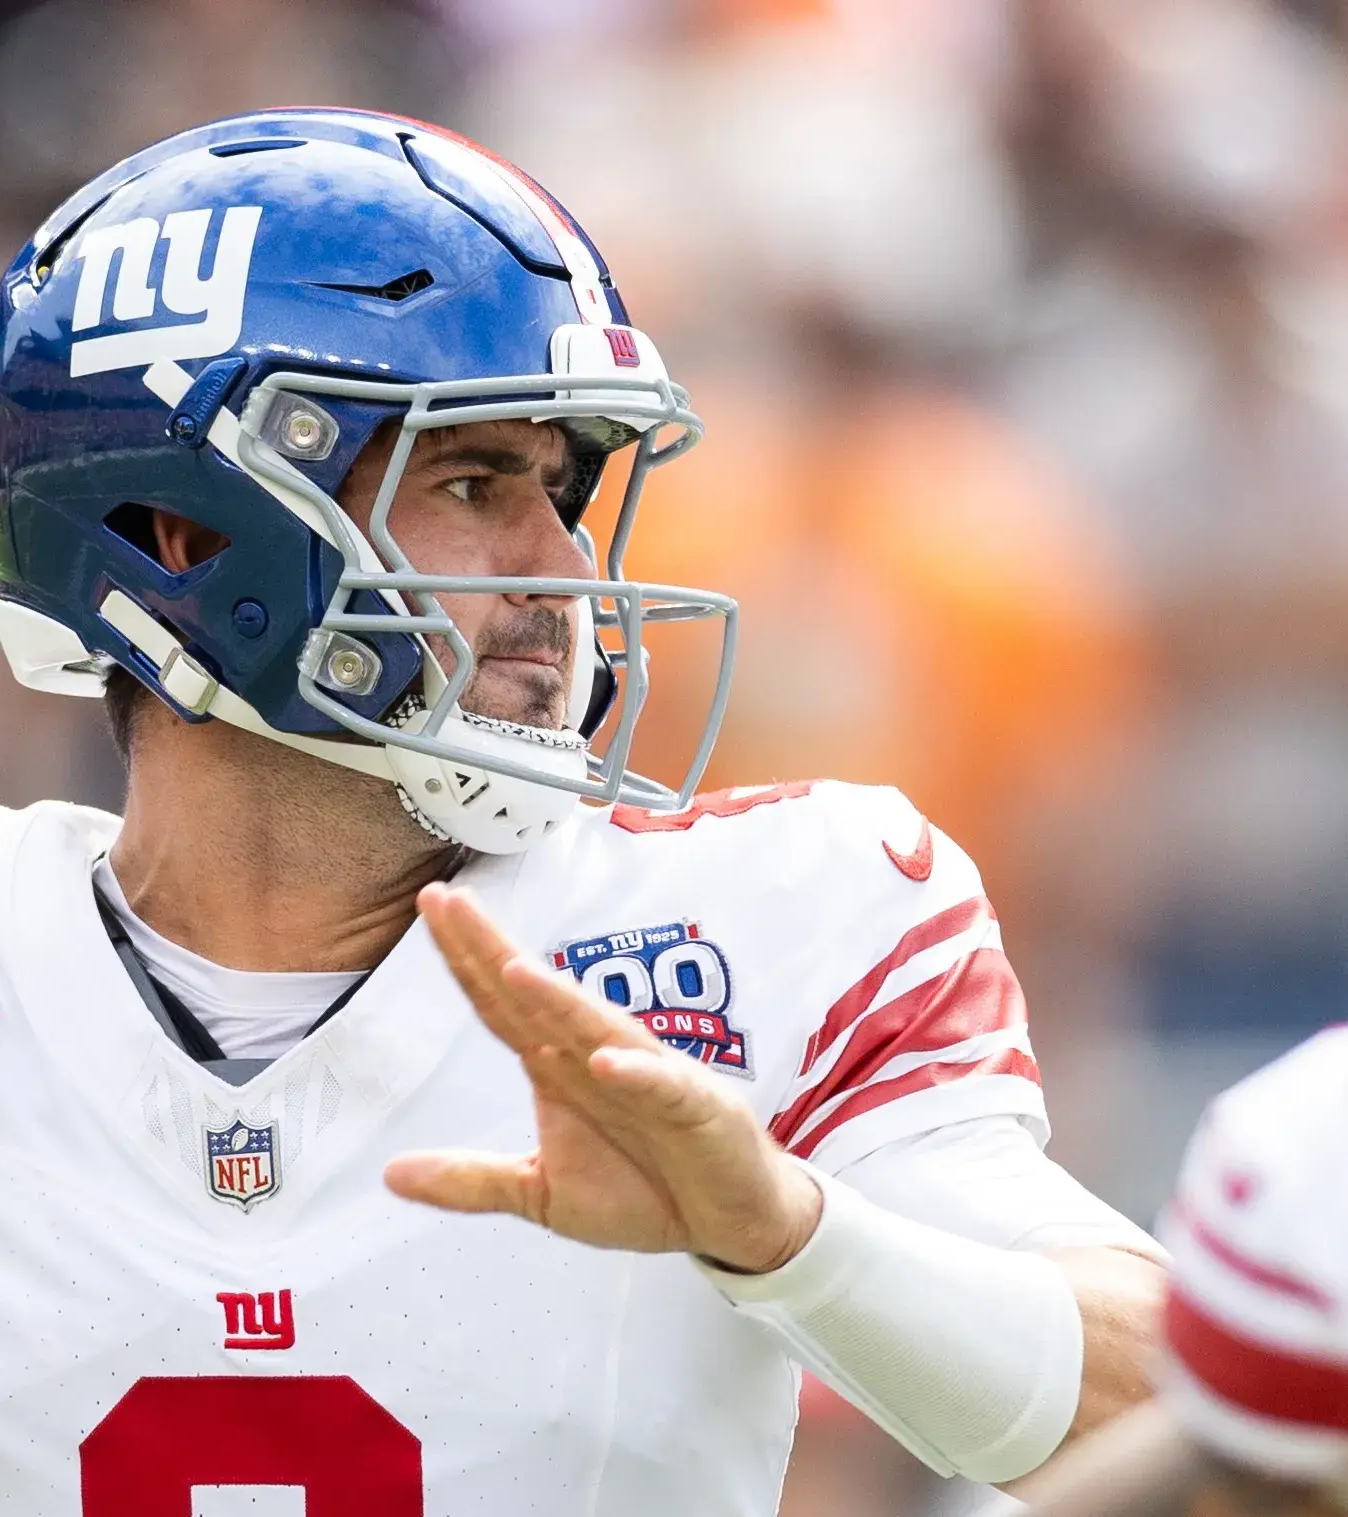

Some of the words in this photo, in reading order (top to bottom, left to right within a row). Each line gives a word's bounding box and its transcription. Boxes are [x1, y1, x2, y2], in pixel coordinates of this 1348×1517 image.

[577, 943, 608, 958] EST.
[645, 929, 680, 945] 1925
[557, 941, 730, 1011] 00
[636, 1013, 716, 1035] ONS
[215, 1155, 269, 1194] NFL
